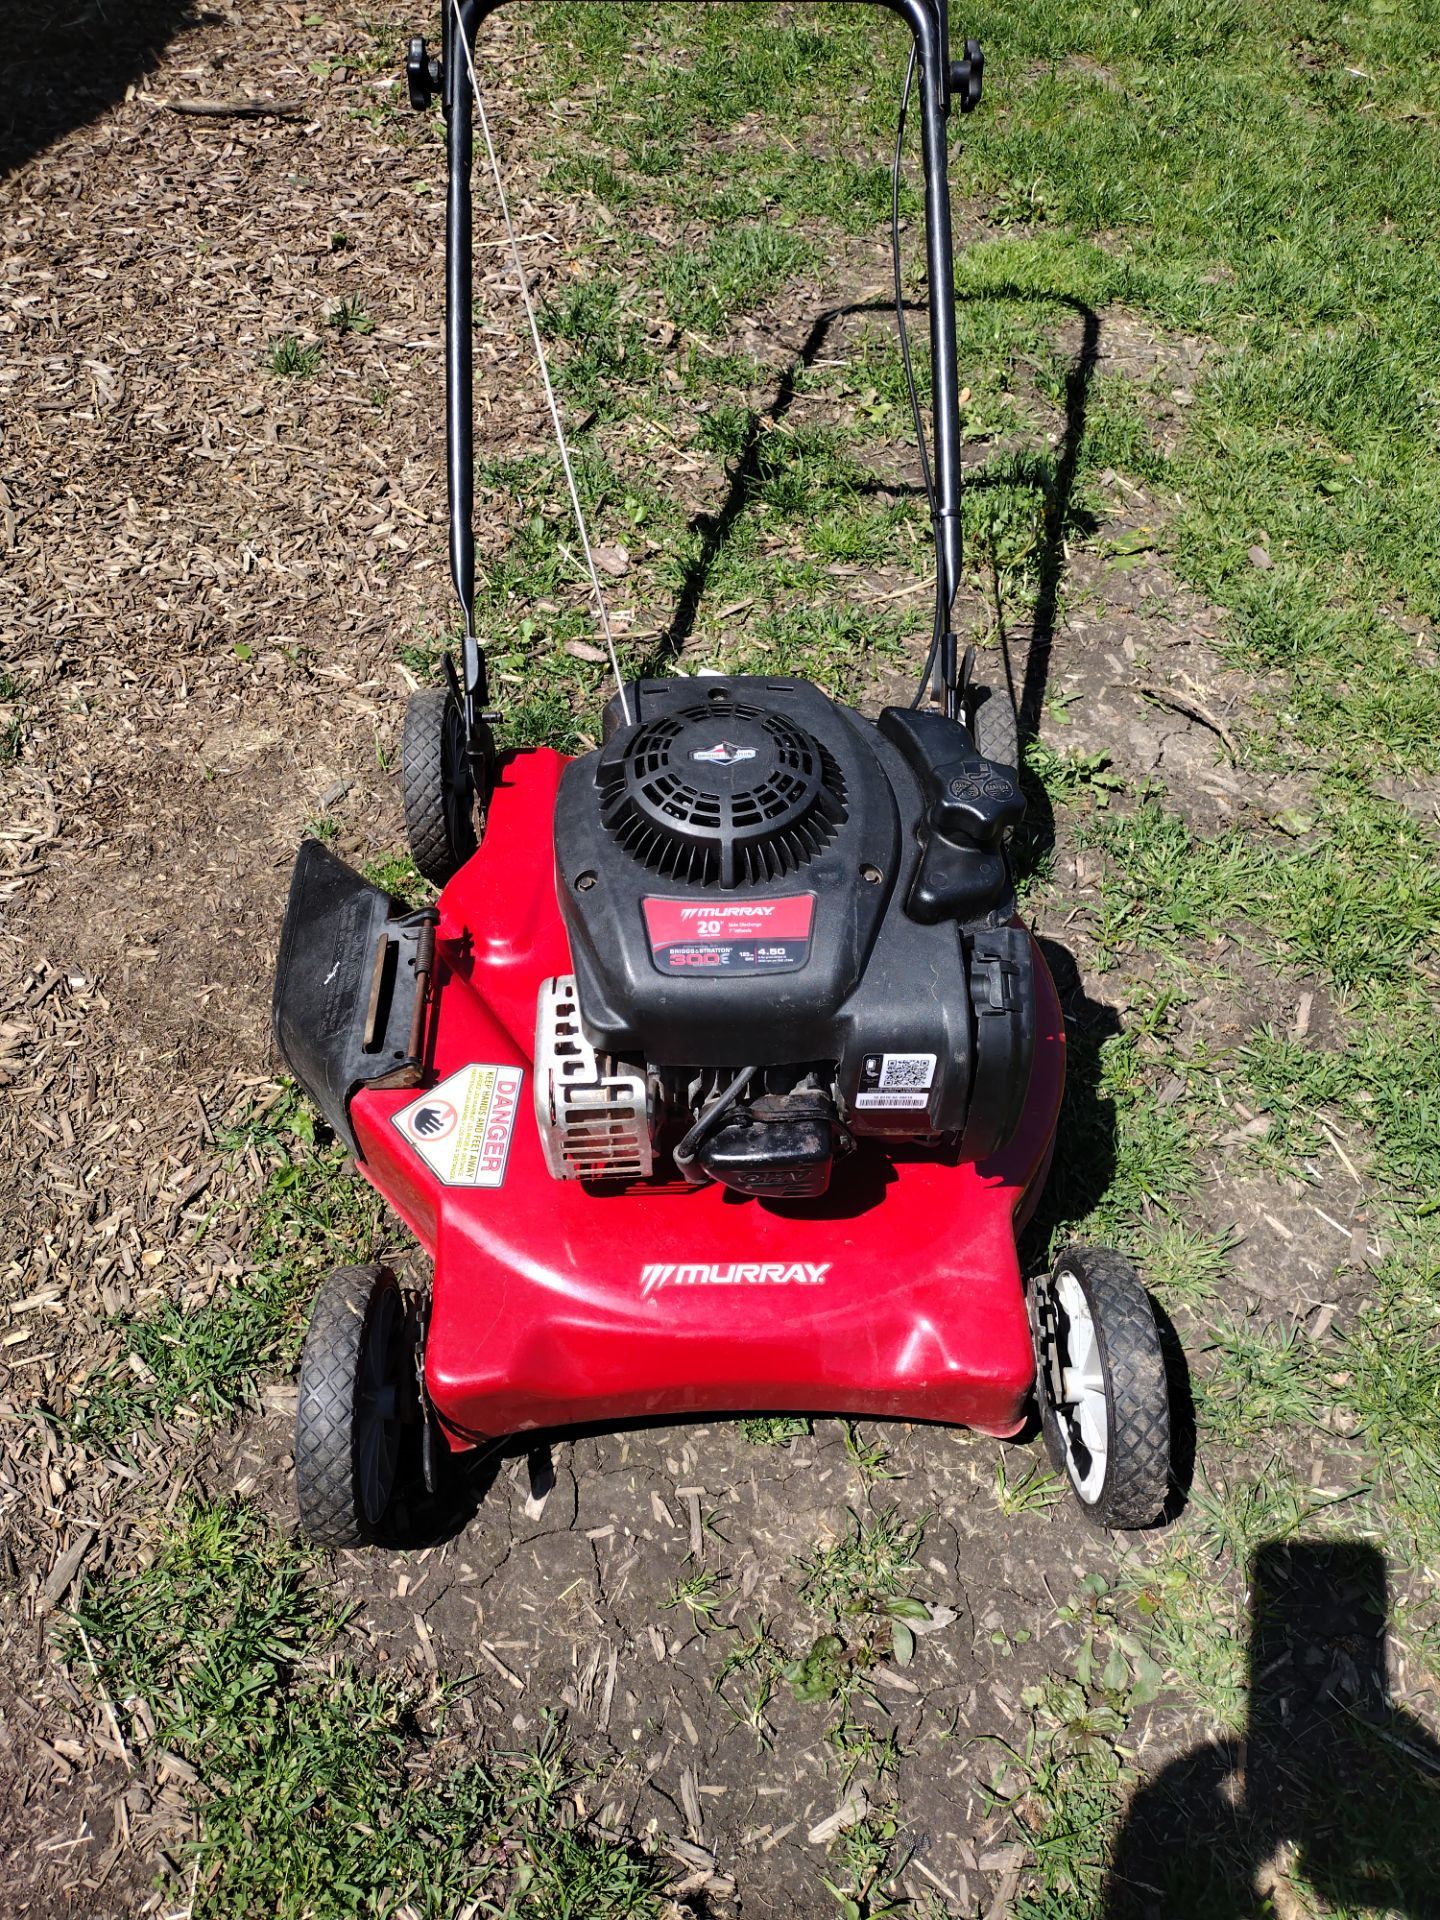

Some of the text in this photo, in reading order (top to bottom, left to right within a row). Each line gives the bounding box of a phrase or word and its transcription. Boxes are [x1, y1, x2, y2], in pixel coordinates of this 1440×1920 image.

[697, 906, 775, 917] MURRAY
[484, 1071, 495, 1089] KEEP
[478, 1090, 491, 1115] HANDS
[474, 1117, 486, 1134] AND
[481, 1080, 517, 1172] DANGER
[470, 1135, 482, 1153] FEET
[466, 1154, 478, 1178] AWAY
[675, 1263, 831, 1284] MURRAY
